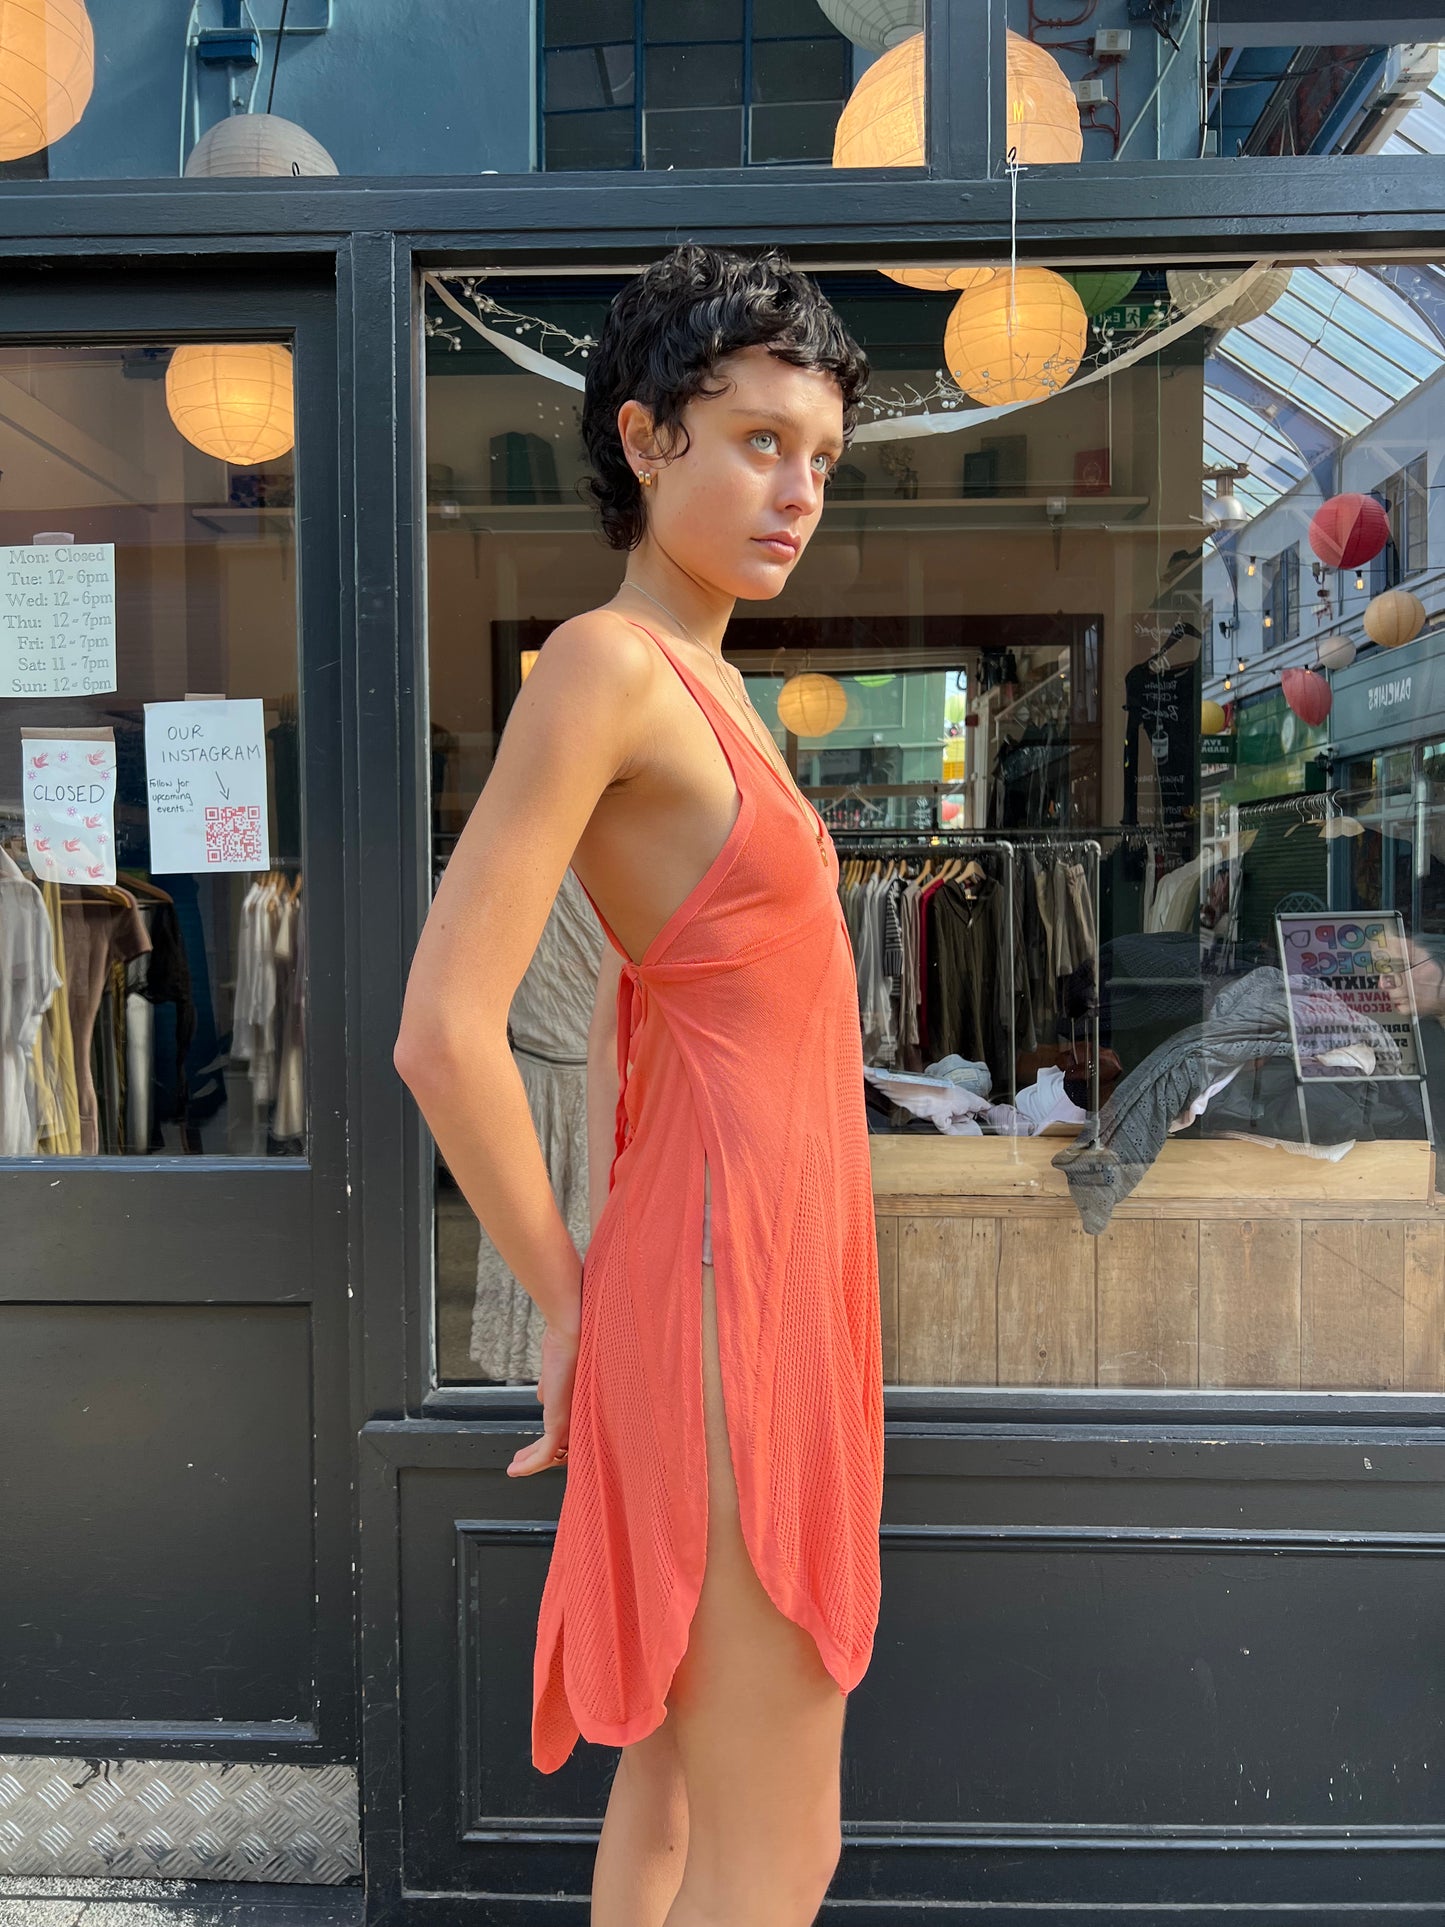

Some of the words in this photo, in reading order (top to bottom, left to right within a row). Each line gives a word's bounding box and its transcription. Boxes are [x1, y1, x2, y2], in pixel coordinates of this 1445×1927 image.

[9, 550, 49, 564] Mon:
[54, 547, 105, 562] Closed
[7, 572, 42, 586] Tue:
[5, 593, 48, 607] Wed:
[3, 615, 42, 629] Thu:
[17, 636, 44, 650] Fri:
[18, 657, 46, 671] Sat:
[11, 678, 47, 692] Sun:
[167, 724, 204, 741] OUR
[161, 744, 261, 763] INSTAGRAM
[149, 778, 173, 788] Follow
[176, 777, 190, 794] for
[33, 784, 105, 804] CLOSED
[152, 792, 194, 807] upcoming
